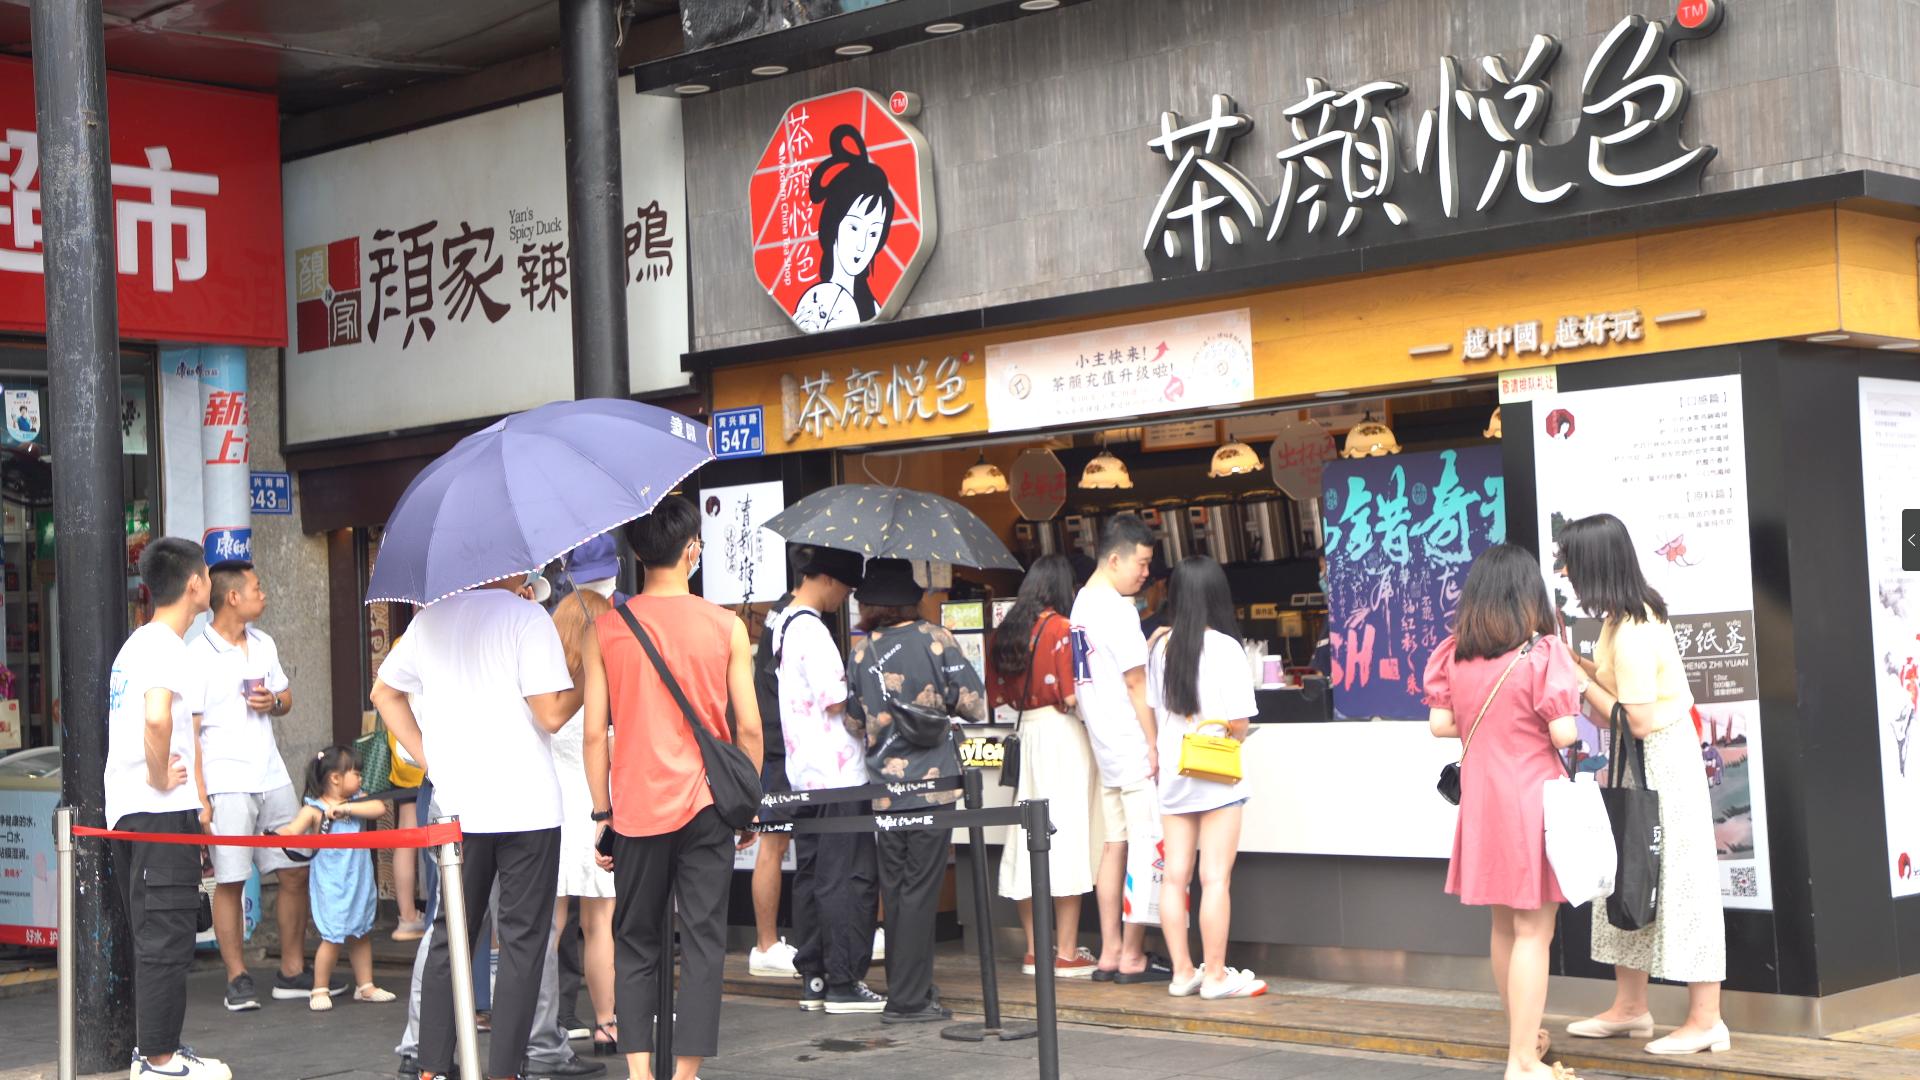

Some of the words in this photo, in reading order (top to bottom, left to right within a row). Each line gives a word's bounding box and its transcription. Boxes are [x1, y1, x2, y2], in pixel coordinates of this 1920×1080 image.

[1680, 3, 1704, 19] TM
[893, 96, 907, 108] TM
[509, 206, 534, 225] Yan's
[509, 226, 535, 244] Spicy
[536, 217, 562, 236] Duck
[782, 237, 790, 259] Tea
[783, 258, 792, 286] Shop
[719, 412, 758, 429] 黄兴南路
[720, 428, 751, 452] 547
[1709, 660, 1723, 670] ZHI
[1724, 658, 1749, 669] YUAN
